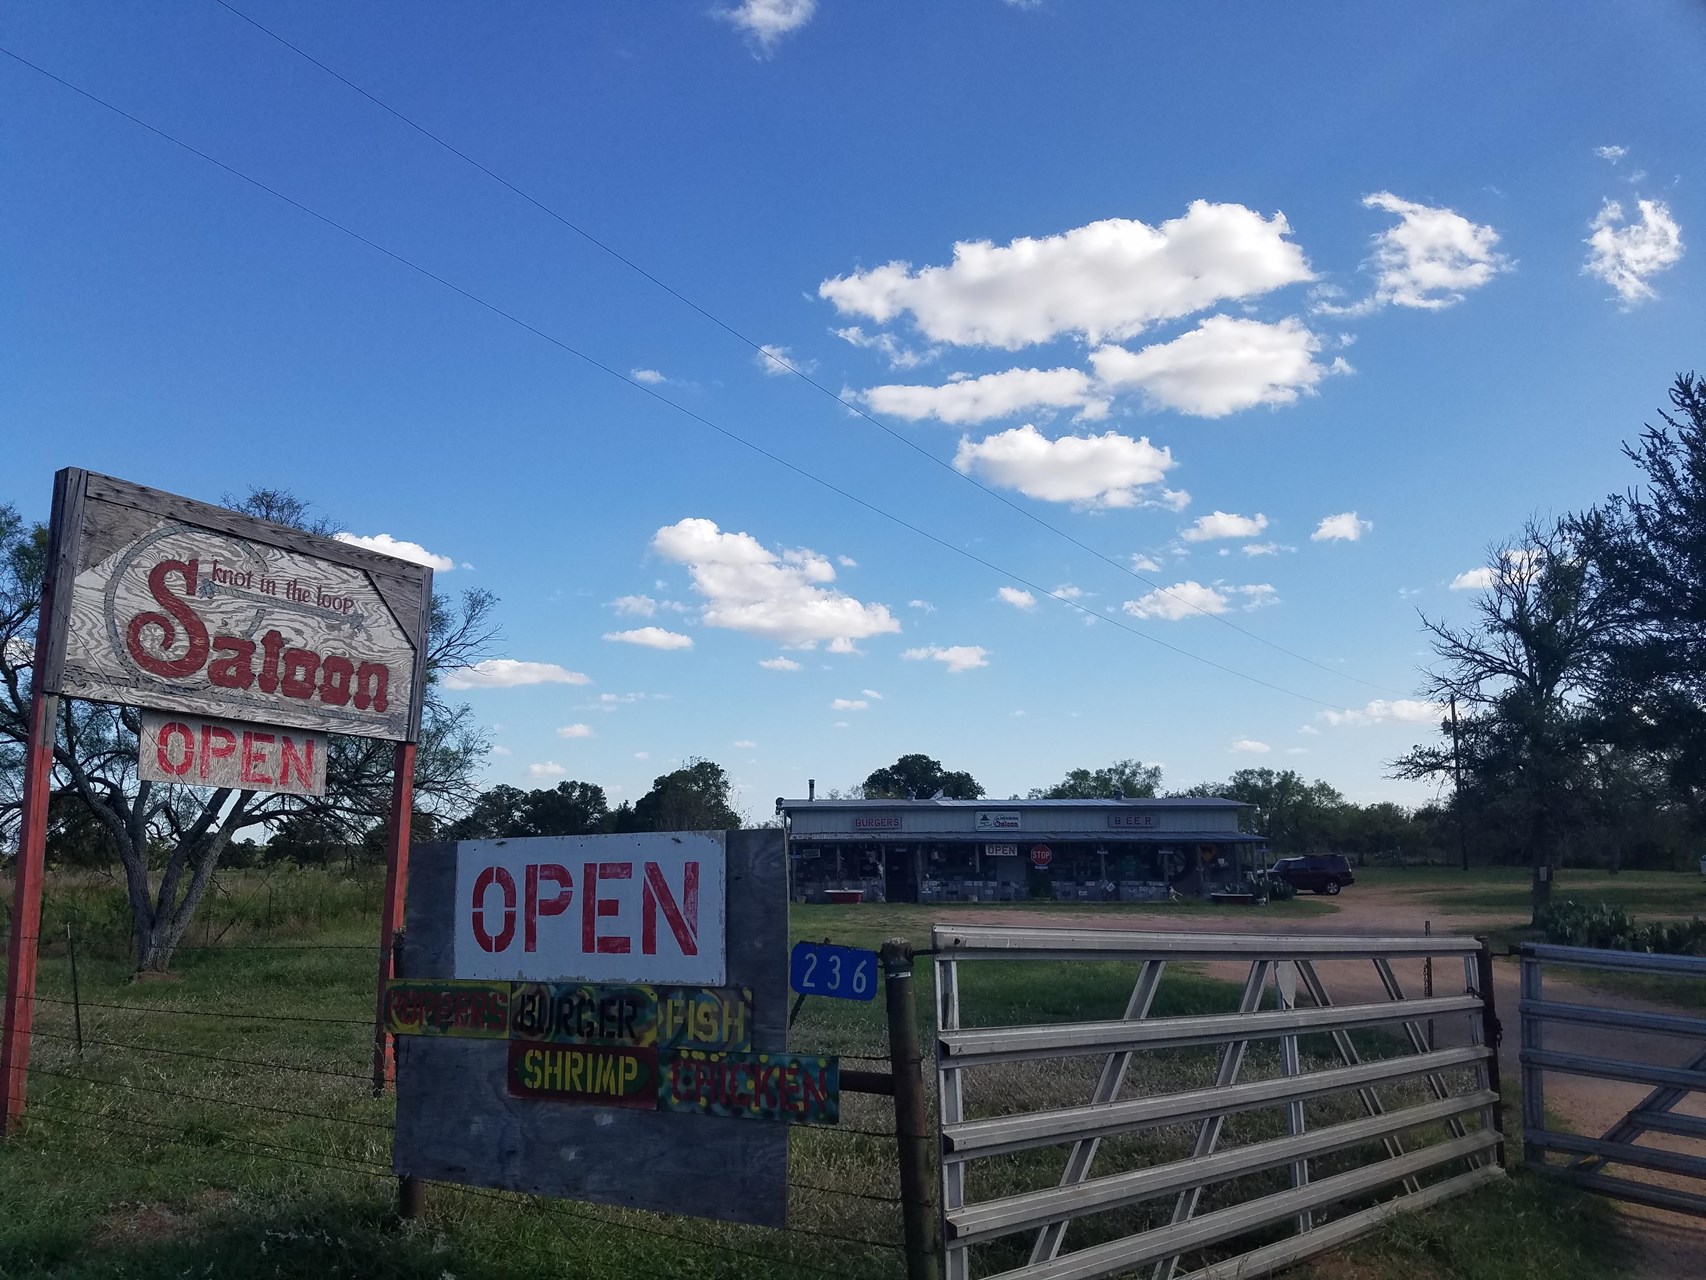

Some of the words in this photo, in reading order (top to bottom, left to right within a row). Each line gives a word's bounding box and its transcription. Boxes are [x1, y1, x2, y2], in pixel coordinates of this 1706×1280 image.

[211, 559, 253, 589] knot
[260, 574, 277, 596] in
[285, 578, 311, 603] the
[316, 585, 354, 614] loop
[126, 559, 390, 712] Saloon
[156, 721, 315, 789] OPEN
[855, 818, 899, 827] BURGERS
[1114, 816, 1152, 825] BEER
[988, 845, 1016, 855] OPEN
[1032, 851, 1050, 859] STOP
[471, 861, 700, 956] OPEN
[802, 952, 868, 994] 236
[520, 994, 638, 1039] BURGER
[666, 998, 745, 1042] FISH
[524, 1049, 638, 1097] SHRIMP
[672, 1059, 827, 1113] CHICKEN
